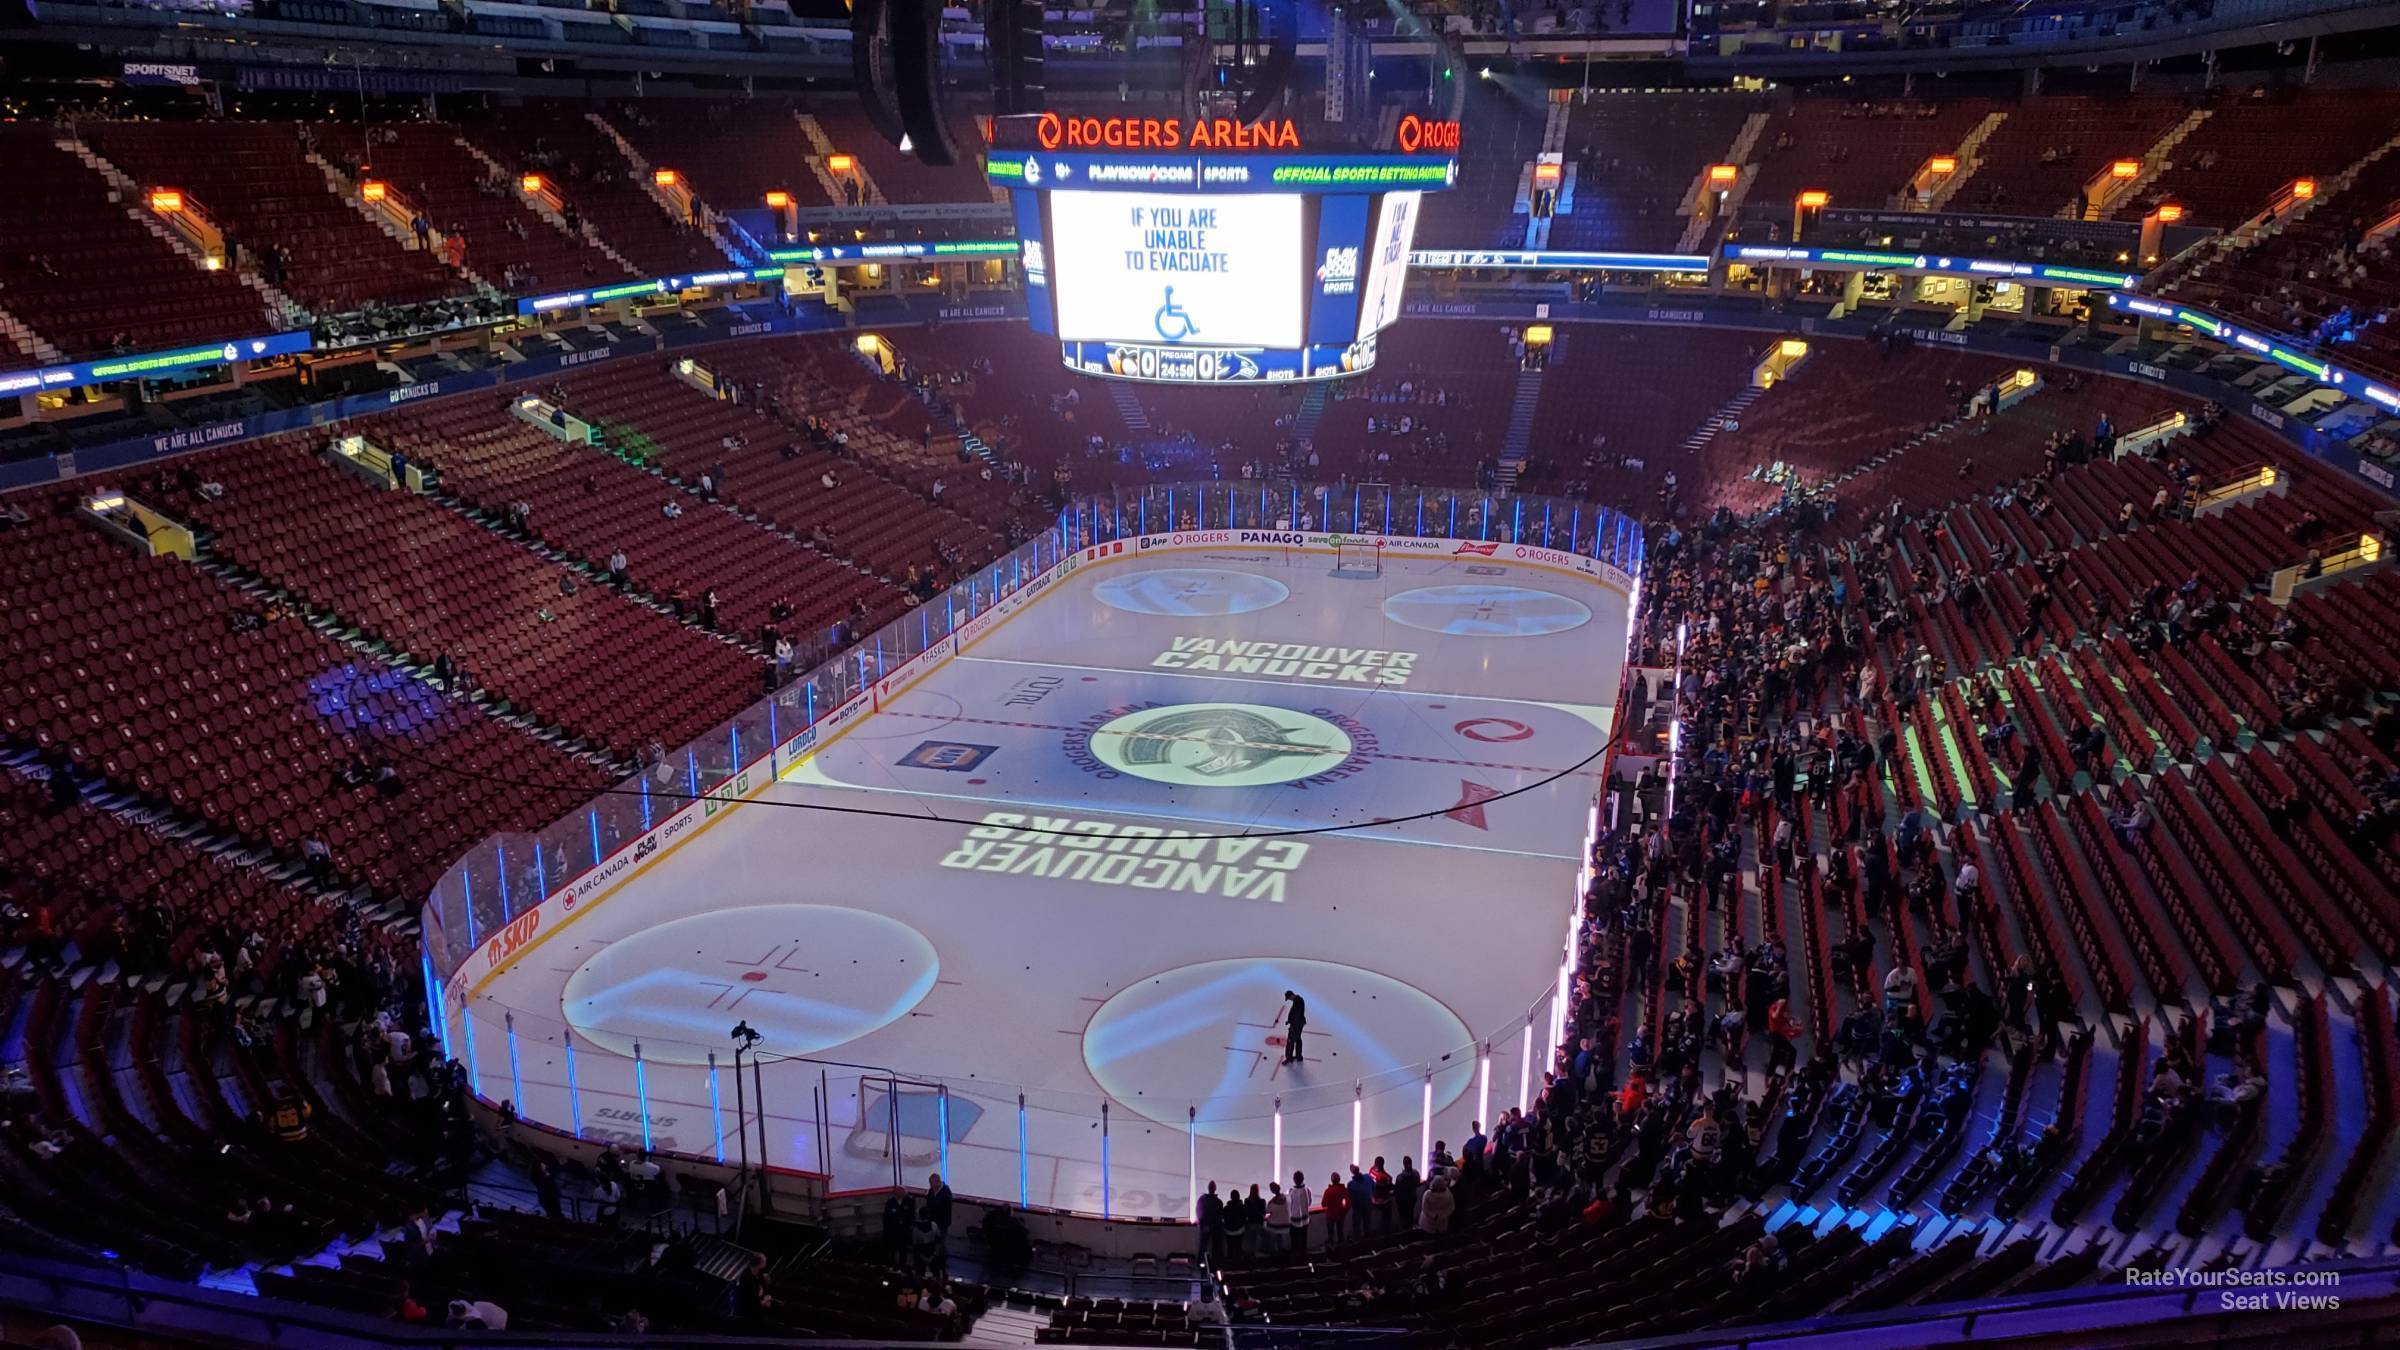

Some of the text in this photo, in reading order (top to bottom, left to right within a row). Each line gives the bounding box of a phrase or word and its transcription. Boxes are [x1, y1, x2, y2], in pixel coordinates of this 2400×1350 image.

[124, 64, 196, 76] SPORTSNET
[1067, 119, 1299, 147] ROGERS ARENA
[1204, 166, 1248, 182] SPORTS
[1273, 166, 1332, 184] OFFICIAL
[1333, 166, 1379, 183] SPORTS
[1379, 166, 1418, 181] BETTING
[1131, 207, 1218, 229] IF YOU ARE
[1145, 230, 1206, 250] UNABLE
[1125, 250, 1229, 273] TO EVACUATE
[1324, 282, 1355, 294] SPORTS
[1141, 351, 1156, 376] 0
[1160, 351, 1194, 360] PREGAME
[1199, 353, 1214, 378] 0
[1160, 364, 1194, 377] 24:50
[1266, 370, 1295, 380] SHOTS
[399, 384, 429, 400] CANUCKS
[154, 422, 244, 452] WE ARE ALL CANUCKS
[1151, 537, 1168, 546] App
[1186, 532, 1230, 543] ROGERS
[1240, 532, 1304, 547] PANAGO
[1388, 540, 1440, 550] AIR CANADA
[1529, 550, 1569, 566] ROGERS
[1026, 573, 1051, 598] GATORADE
[970, 614, 992, 635] ROGERS
[926, 639, 950, 664] FASKEN
[1169, 635, 1418, 669] VANCOUVER
[1151, 650, 1413, 685] CANUCKS
[839, 702, 859, 720] BOYD
[788, 726, 817, 756] LORDCO
[664, 813, 694, 839] SPORTS
[637, 833, 657, 853] PLAY
[637, 842, 658, 861] NOW
[968, 812, 1311, 871] CANUCKS
[578, 856, 629, 898] AIR CANADA
[939, 839, 1286, 903] VANCOUVER
[502, 909, 540, 957] SKIP
[1590, 1138, 1610, 1154] 53
